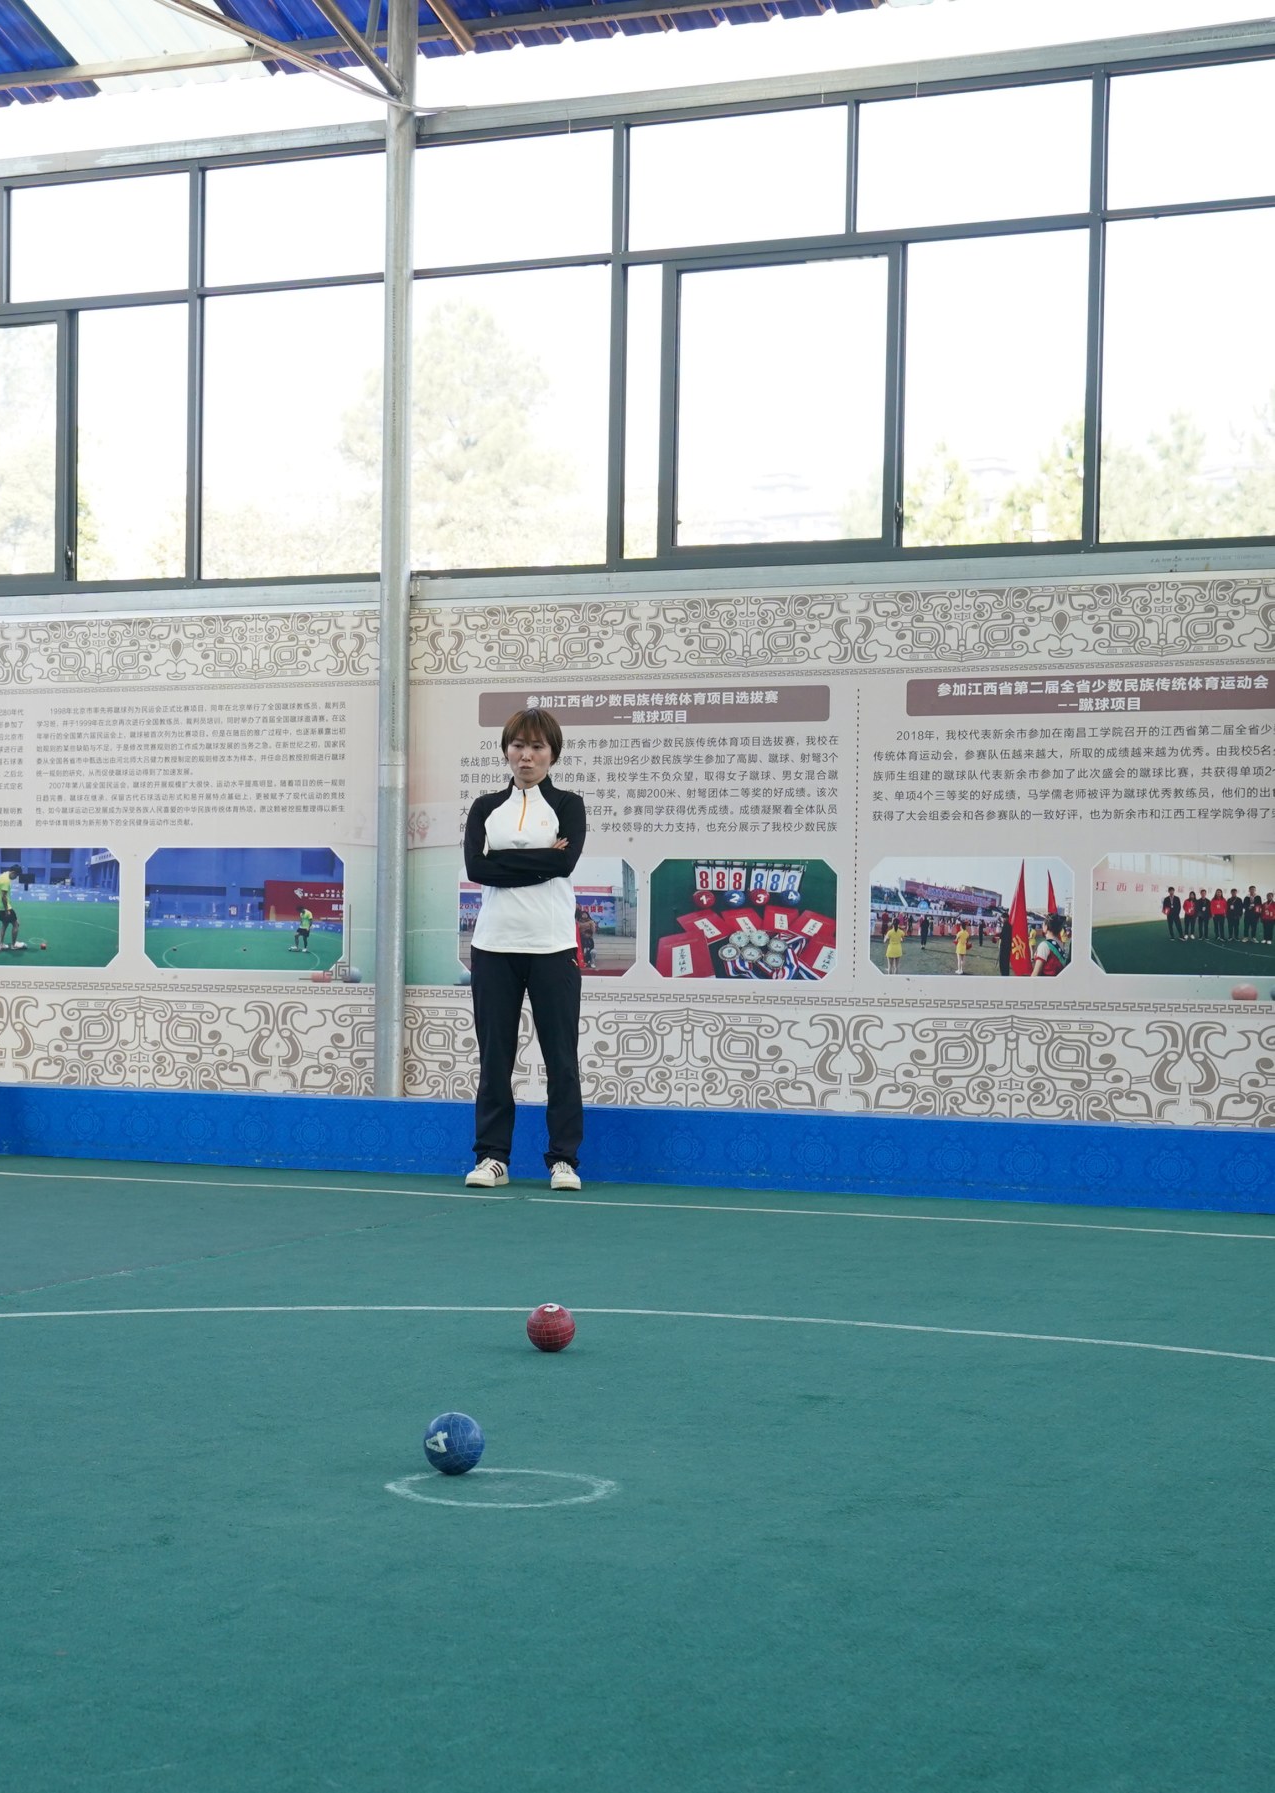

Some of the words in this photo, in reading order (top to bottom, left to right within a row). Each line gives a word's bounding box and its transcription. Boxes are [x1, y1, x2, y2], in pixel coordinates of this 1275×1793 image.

[937, 675, 1269, 697] 参加江西省第二届全省少数民族传统体育运动会
[526, 690, 778, 709] 参加江西省少数民族传统体育项目选拔赛
[896, 723, 1275, 741] 2018年，我校代表新余市参加在南昌工学院召开的江西省第二届全省少
[561, 735, 839, 750] 新余市参加江西省少数民族传统体育项目选拔赛，我校在
[873, 745, 1275, 762] 传统体育运动会，参赛队伍越来越大，所取的成绩越来越为优秀。由我校5名
[873, 765, 1275, 782] 族师生组建的蹴球队代表新余市参加了此次盛会的蹴球比赛，共获得单项2
[873, 786, 1275, 802] 奖、单项4个三等奖的好成绩，马学儒老师被评为蹴球优秀教练员，他们的出
[425, 1430, 448, 1454] 4
